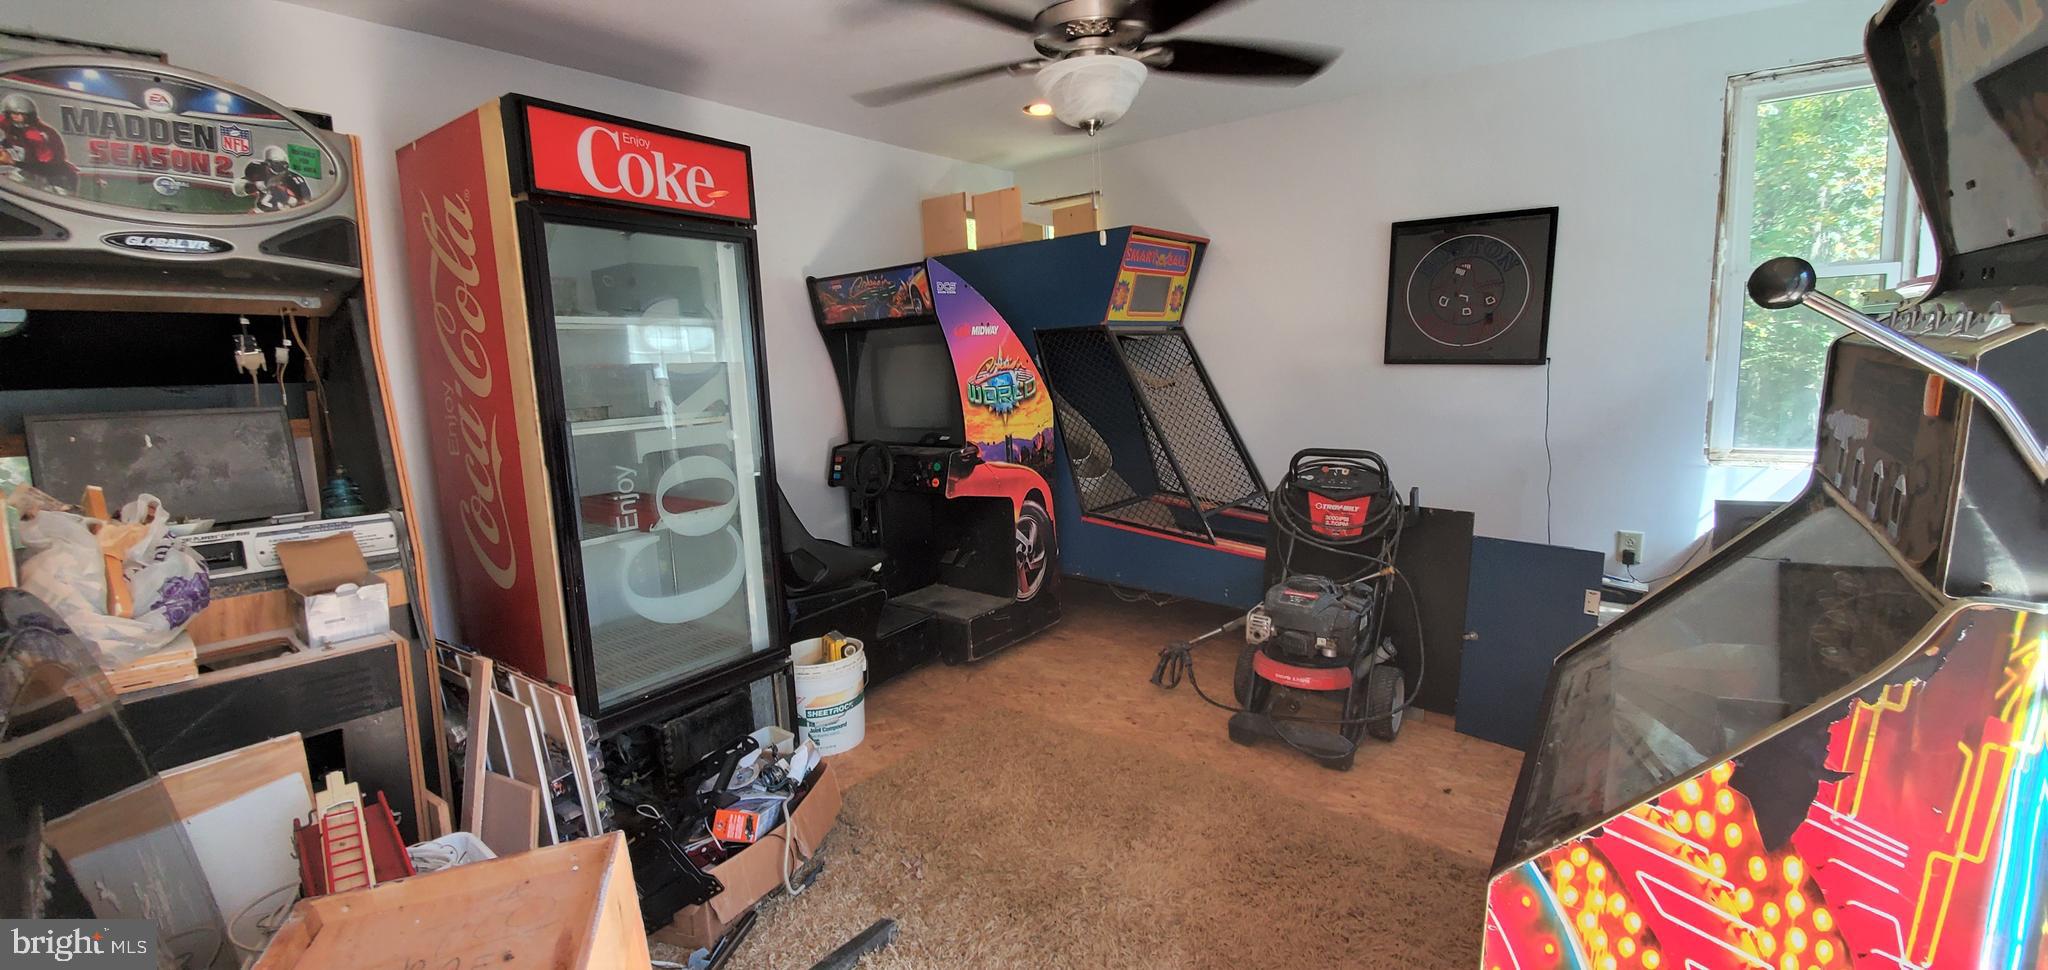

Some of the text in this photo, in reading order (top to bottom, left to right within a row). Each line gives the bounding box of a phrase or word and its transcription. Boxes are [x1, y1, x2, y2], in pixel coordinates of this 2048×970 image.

[60, 105, 218, 153] MADDEN
[223, 135, 249, 152] NFL
[622, 133, 650, 149] Enjoy
[88, 138, 235, 180] SEASON 2
[576, 125, 716, 208] Coke
[971, 325, 998, 336] MIDWAY
[420, 190, 518, 591] Coca-Cola
[967, 378, 1036, 405] WORLD
[443, 381, 460, 456] Enjoy
[615, 464, 640, 533] Enjoy
